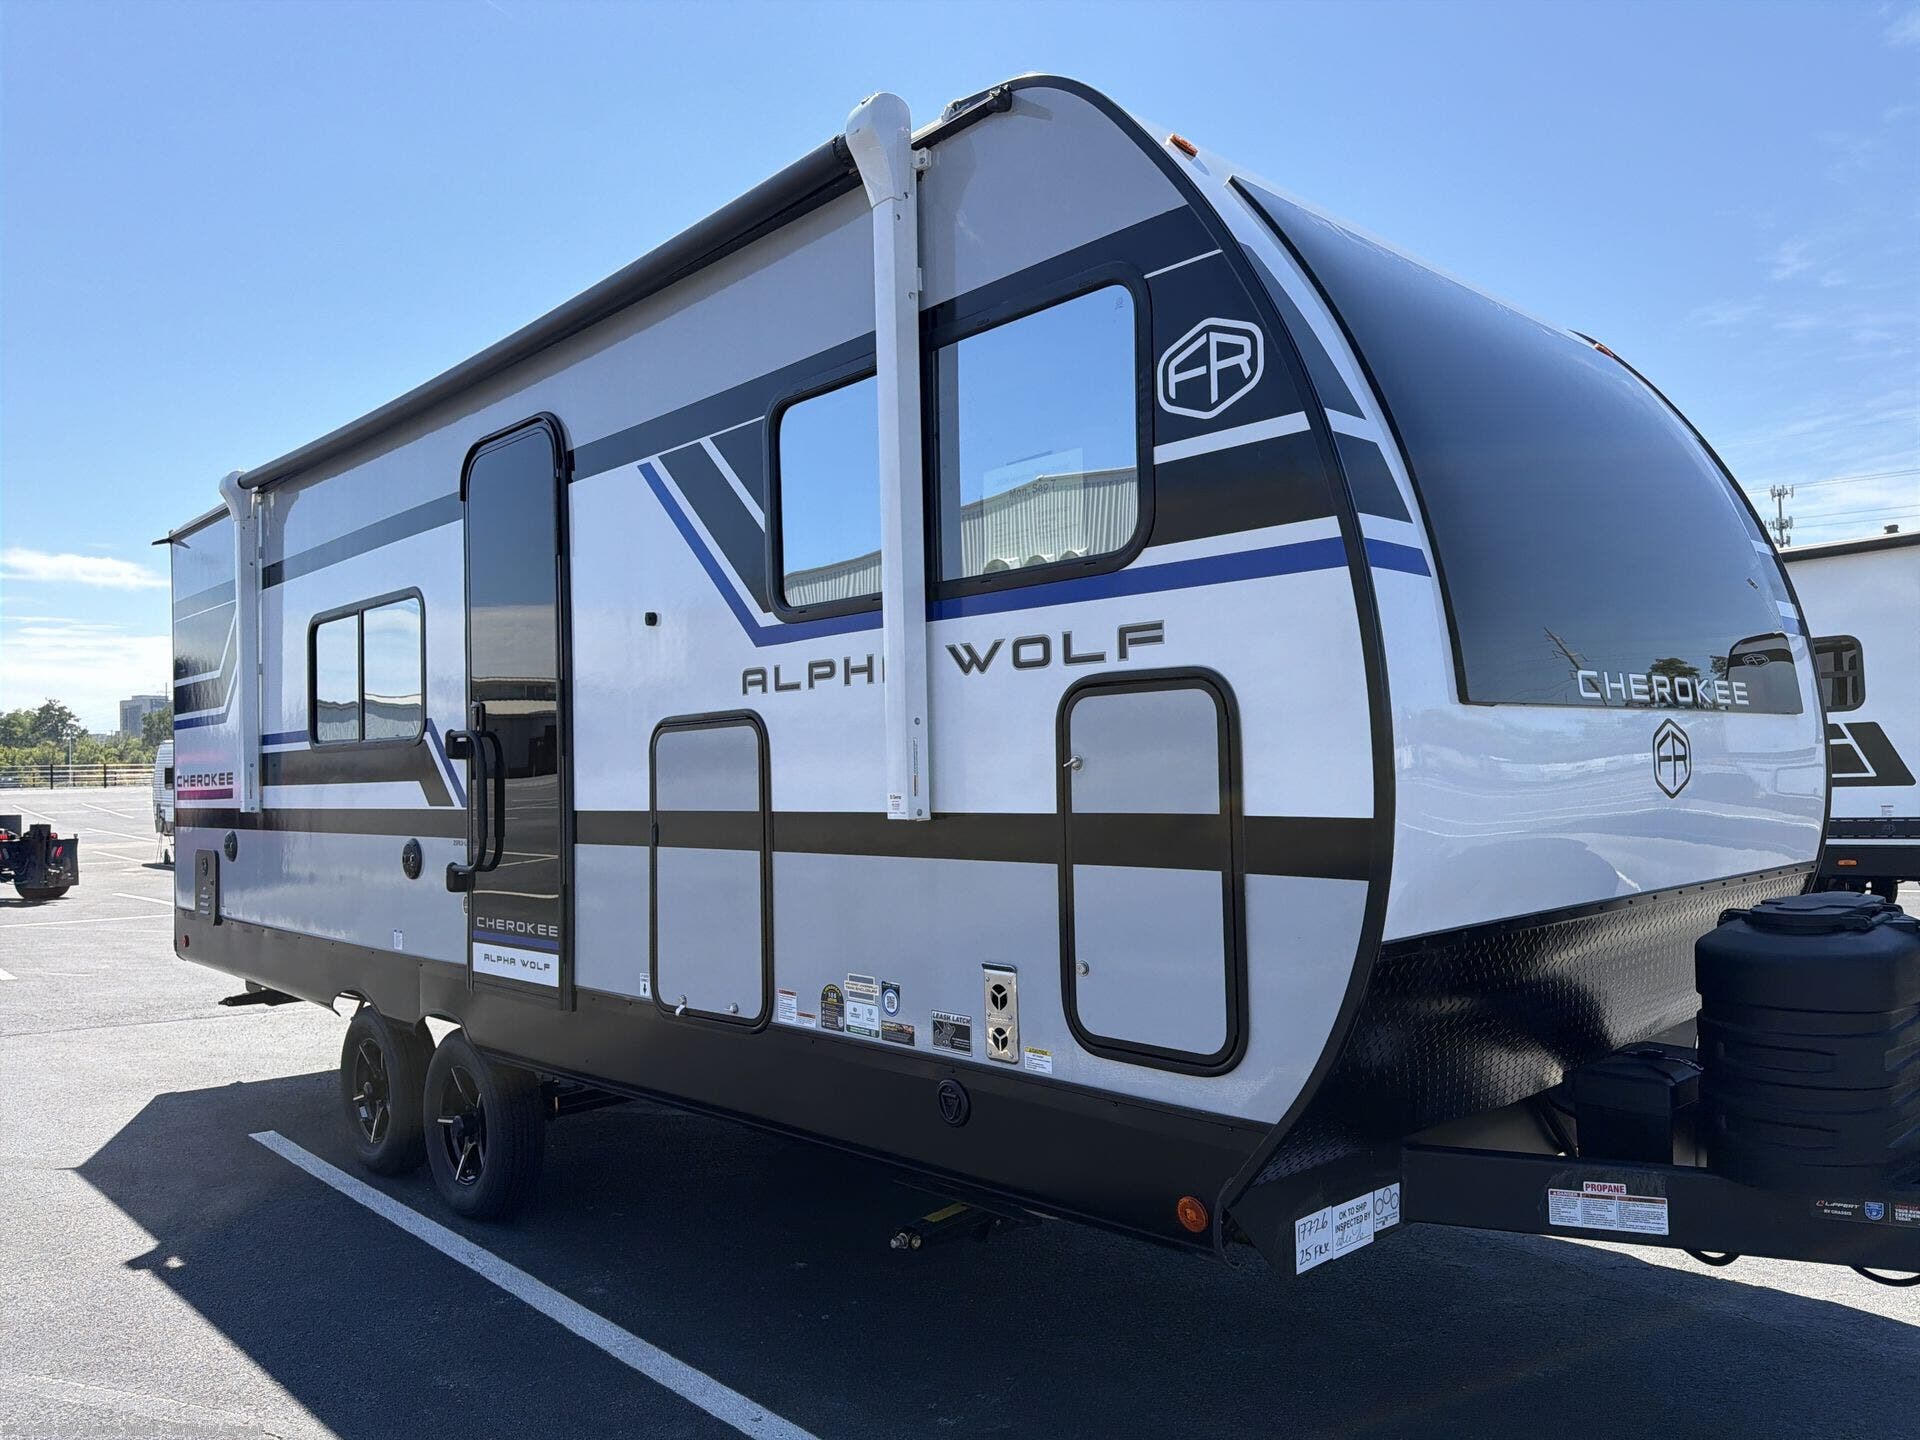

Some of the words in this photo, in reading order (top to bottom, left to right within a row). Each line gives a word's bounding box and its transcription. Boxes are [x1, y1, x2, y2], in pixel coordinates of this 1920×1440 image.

[1032, 483, 1049, 494] Sep
[742, 653, 885, 697] ALPH
[944, 619, 1166, 677] WOLF
[1577, 669, 1750, 706] CHEROKEE
[176, 772, 234, 788] CHEROKEE
[476, 916, 559, 937] CHEROKEE
[483, 953, 516, 966] ALPHA
[520, 959, 550, 971] WOLF
[932, 1011, 951, 1021] LEASH
[952, 1014, 971, 1025] LATCH
[1585, 1183, 1625, 1194] PROPANE
[1339, 1210, 1347, 1220] OK
[1348, 1206, 1355, 1216] TO
[1355, 1201, 1367, 1213] SHIP
[1297, 1212, 1328, 1243] 17726
[1335, 1215, 1364, 1233] INSPECTED
[1364, 1211, 1371, 1221] BY
[1300, 1243, 1314, 1265] 25
